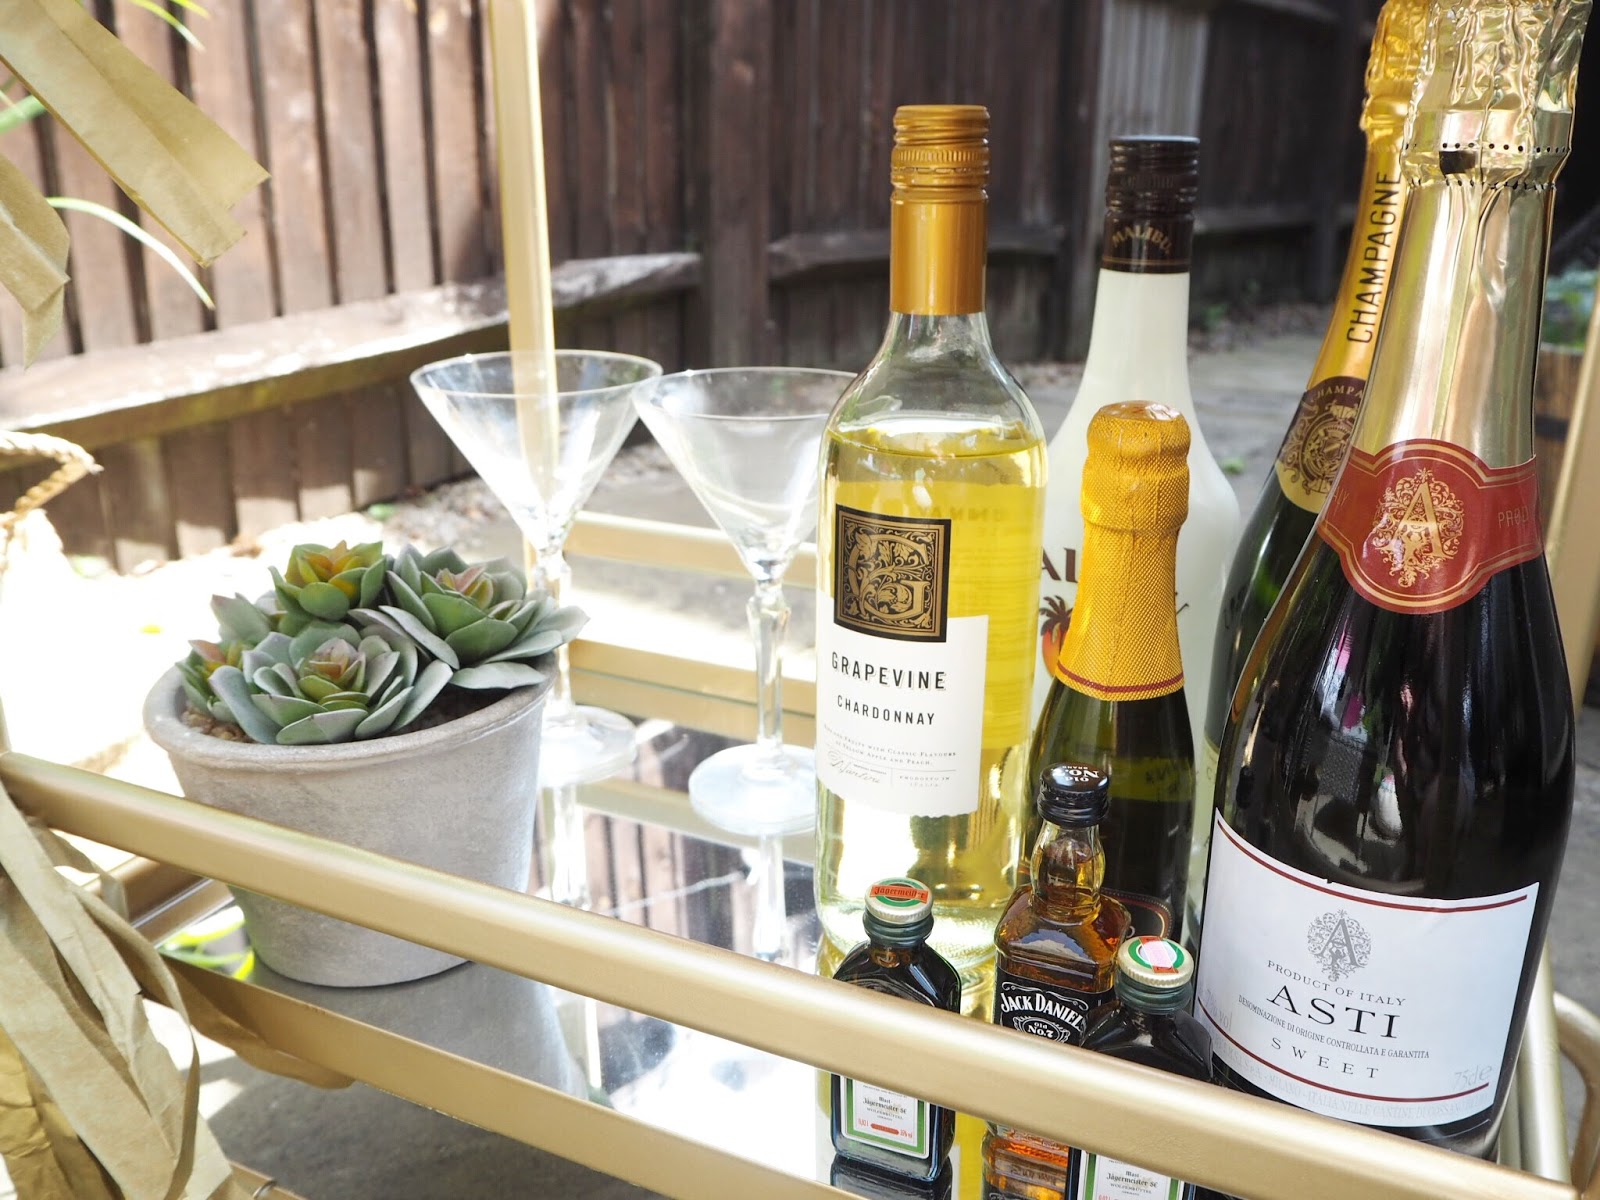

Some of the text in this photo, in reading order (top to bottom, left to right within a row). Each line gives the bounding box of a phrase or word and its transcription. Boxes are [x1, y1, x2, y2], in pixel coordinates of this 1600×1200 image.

[1112, 225, 1172, 252] MALIBU
[1346, 171, 1401, 343] CHAMPAGNE
[831, 651, 946, 690] GRAPEVINE
[837, 694, 935, 726] CHARDONNAY
[1267, 960, 1407, 1006] PRODUCT OF ITALY
[1000, 992, 1086, 1032] JACK DANIEL
[1027, 1025, 1054, 1038] No.7
[1238, 994, 1430, 1059] DENOMINAZIONE DI ORIGINE CONTROLLATA E GARANTITA
[1266, 984, 1401, 1039] ASTI
[1271, 1037, 1380, 1079] SWEET
[1106, 1172, 1149, 1187] Jägermeister
